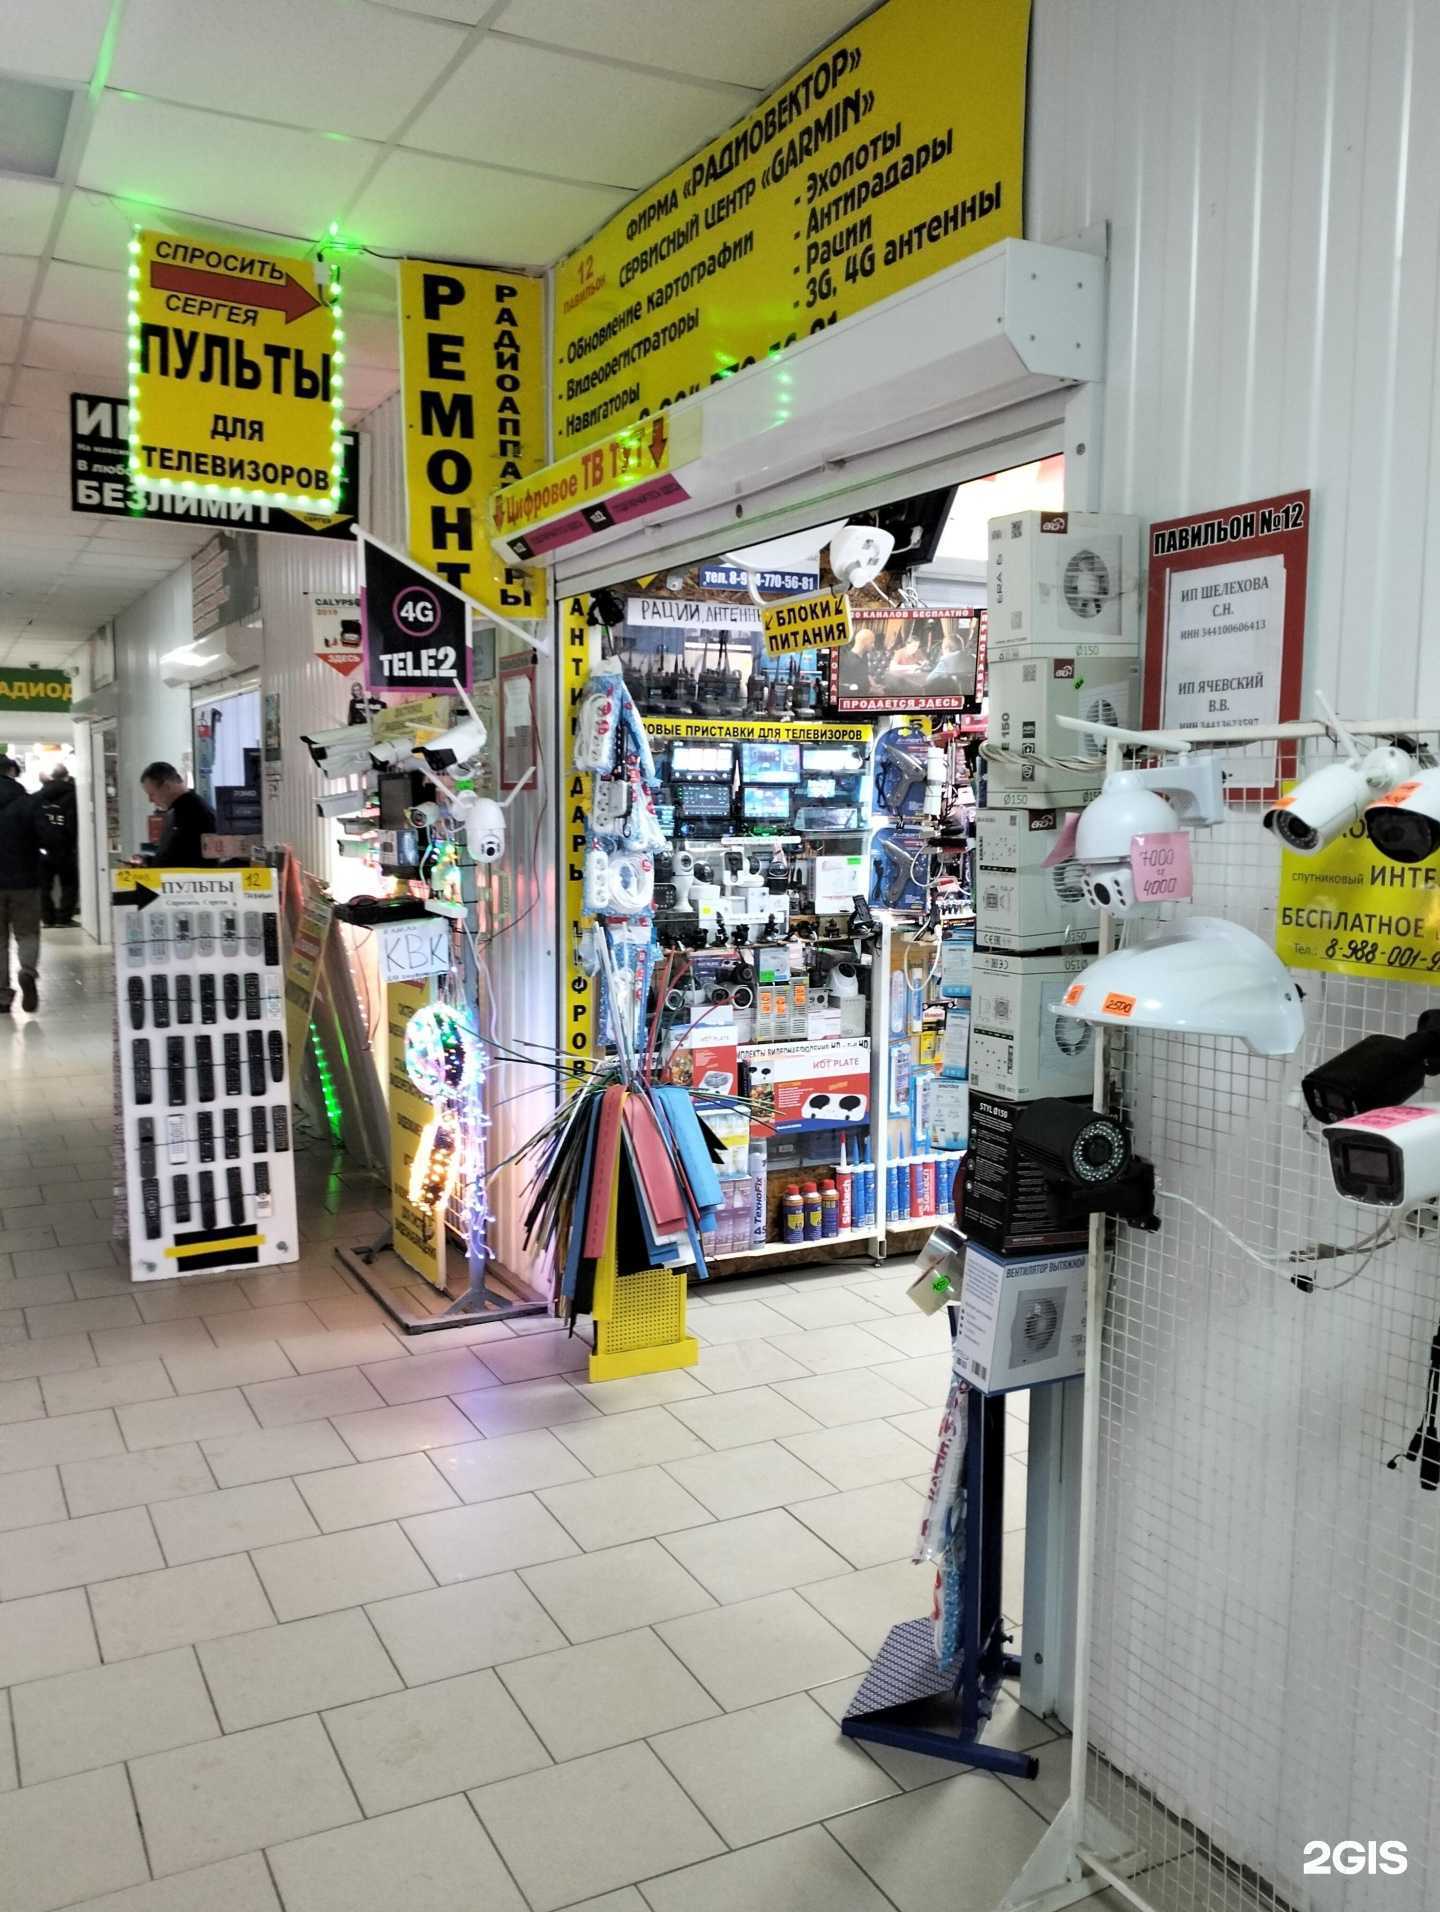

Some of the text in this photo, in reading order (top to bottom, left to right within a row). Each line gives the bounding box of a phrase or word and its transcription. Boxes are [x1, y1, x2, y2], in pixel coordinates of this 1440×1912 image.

[626, 47, 862, 241] ФИРМА «РАДИОВЕКТОР»
[806, 121, 902, 204] Эхолоты
[618, 88, 876, 288] СЕРВИСНЫЙ ЦЕНТР «GARMIN»
[806, 128, 954, 240] Антирадары
[806, 214, 873, 274] Рации
[806, 181, 1003, 308] 3G, 4G антенны
[155, 241, 285, 282] СПРОСИТЬ
[577, 255, 594, 284] 12
[165, 293, 258, 327] СЕРГЕЯ
[566, 230, 754, 365] Обновление картографии
[140, 322, 332, 402] ПУЛЬТЫ
[566, 308, 700, 401] Видеорегистраторы
[566, 383, 641, 437] Навигаторы
[419, 273, 475, 591] РЕМОНТ
[143, 445, 329, 491] ТЕЛЕВИЗОРОВ
[77, 480, 270, 524] БЕЗЛИМИТ
[506, 474, 578, 526] Цифровое
[581, 448, 604, 491] ТВ
[1153, 502, 1305, 555] ПАВИЛЬОН №12
[704, 570, 815, 590] тел. 8-94-770-56-81
[1181, 576, 1270, 602] ИП ШЕЛЕХОВА
[400, 601, 434, 623] 4G
[777, 602, 832, 627] БЛОКИ
[1212, 602, 1235, 617] С.Н.
[768, 622, 847, 652] ПИТАНИЯ
[379, 646, 458, 678] TELE2
[1178, 672, 1264, 695] ИП ЯЧЕВСКИЙ
[843, 698, 959, 709] ПРОДАЕТСЯ ЗДЕСЬ
[1208, 699, 1231, 713] В.В.
[685, 726, 754, 737] ПРИСТАВКИ
[758, 730, 781, 739] ДЛЯ
[785, 728, 862, 740] ТЕЛЕВИЗОРОВ
[1001, 712, 1010, 738] 150
[161, 881, 235, 895] ПУЛЬТЫ
[1292, 872, 1365, 885] спутниковый
[1282, 907, 1425, 938] БЕСПЛАТНОЕ
[1325, 938, 1440, 971] 8-988-001-9
[834, 1058, 860, 1067] PLATE
